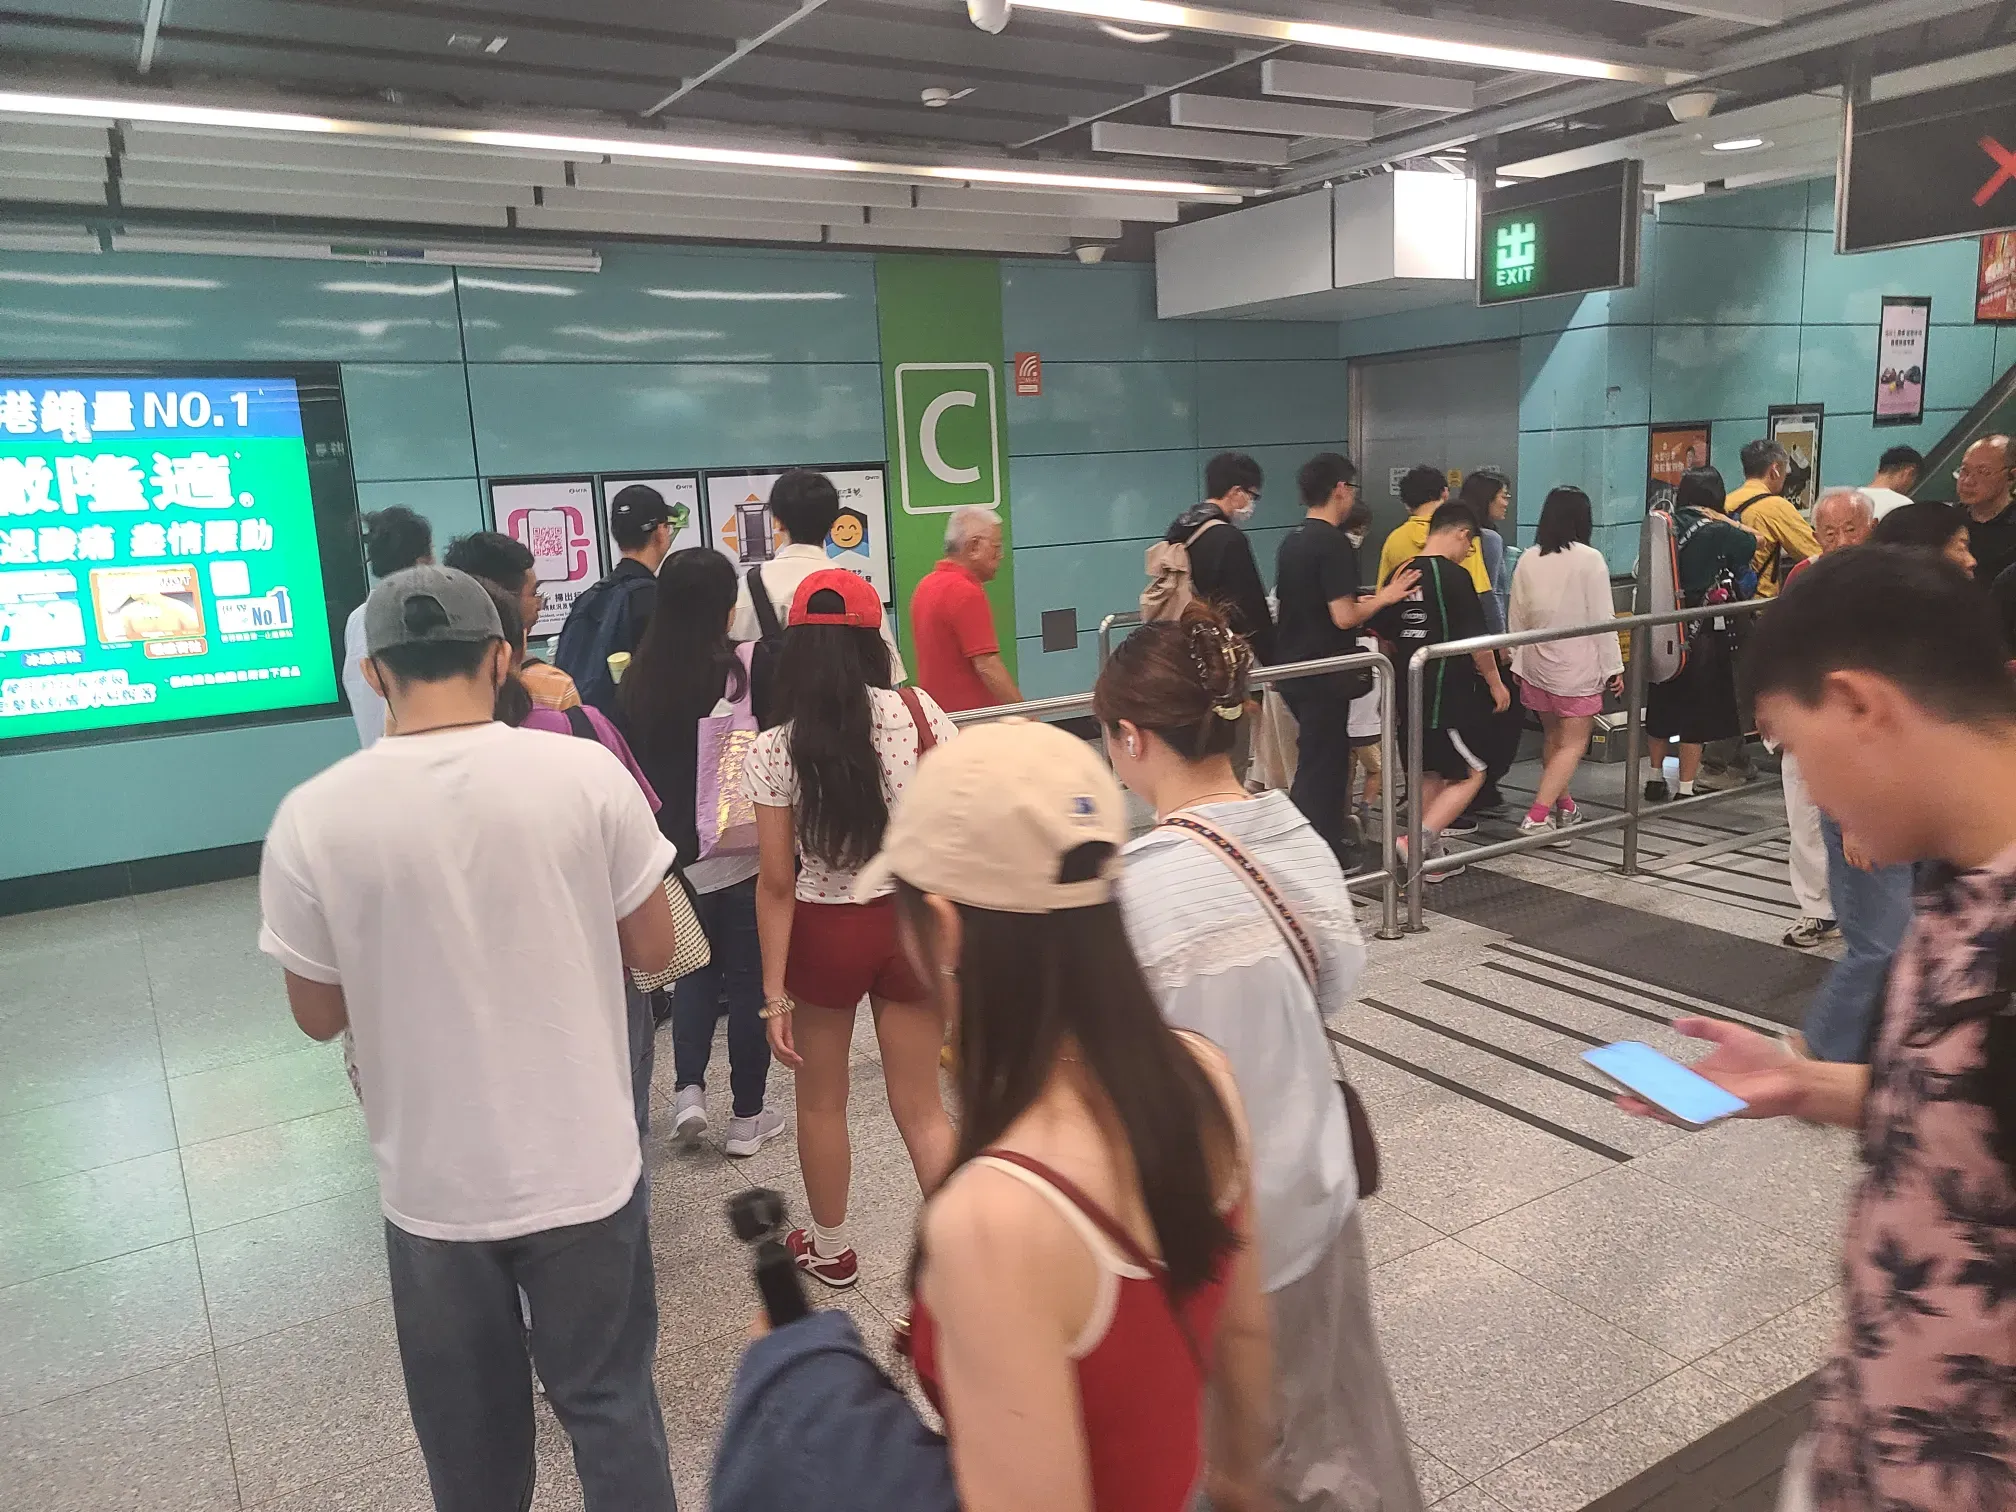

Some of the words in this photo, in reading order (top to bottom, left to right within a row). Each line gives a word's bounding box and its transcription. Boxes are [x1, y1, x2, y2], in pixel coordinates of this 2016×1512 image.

[1496, 222, 1535, 269] 出
[1496, 265, 1534, 286] EXIT
[143, 391, 248, 428] NO.1
[919, 390, 981, 484] C
